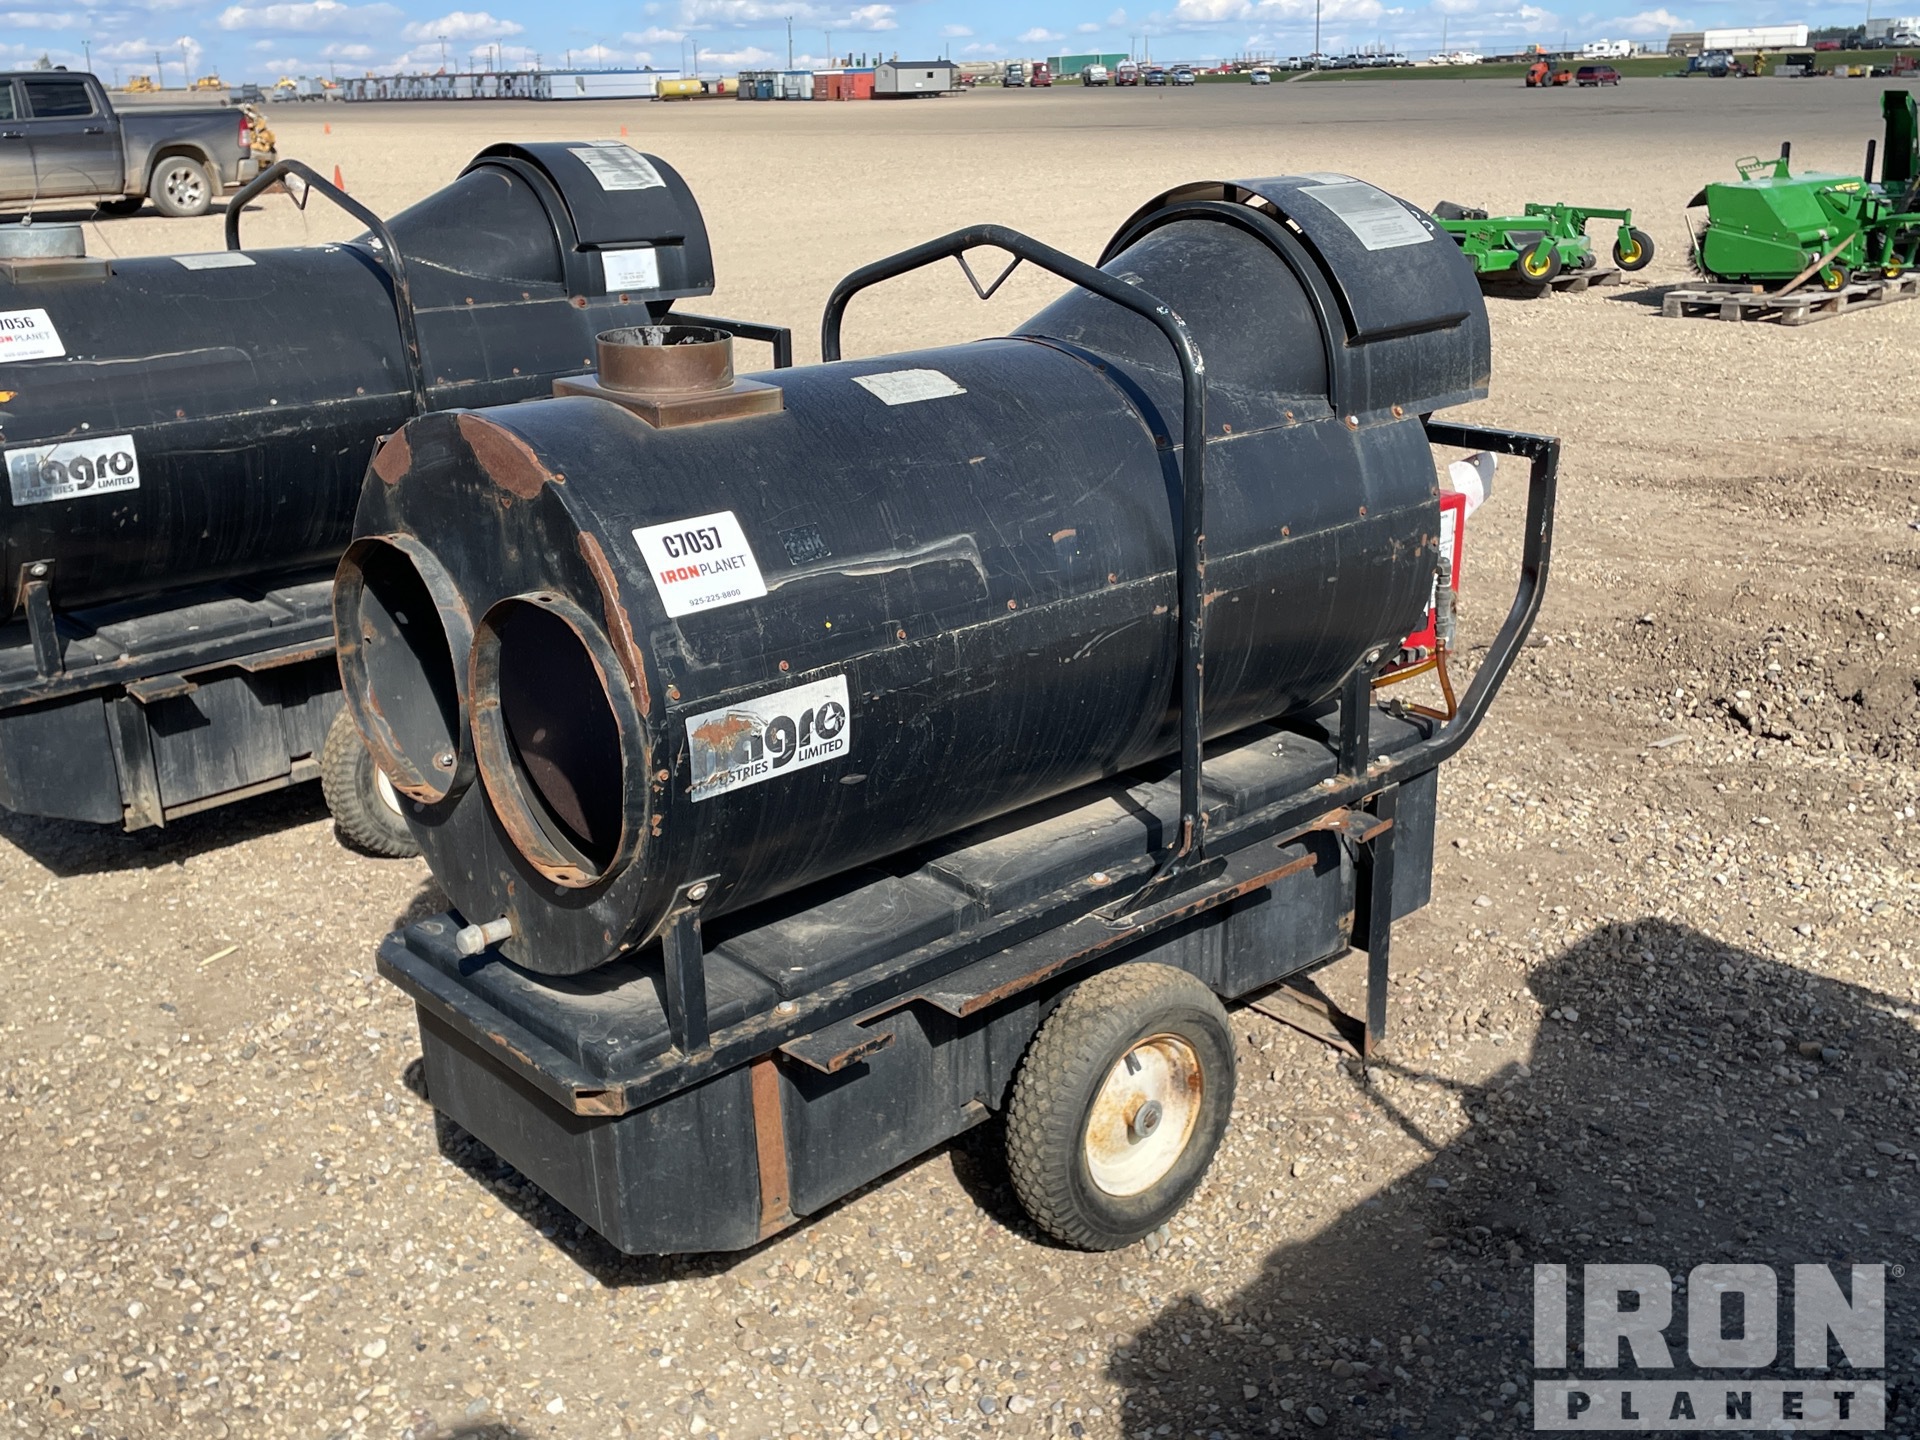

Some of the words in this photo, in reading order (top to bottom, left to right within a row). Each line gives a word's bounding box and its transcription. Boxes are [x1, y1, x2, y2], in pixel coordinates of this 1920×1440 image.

[98, 476, 135, 489] LIMITED
[662, 526, 722, 558] C7057
[688, 588, 741, 606] 925-225-8800
[798, 738, 844, 762] LIMITED
